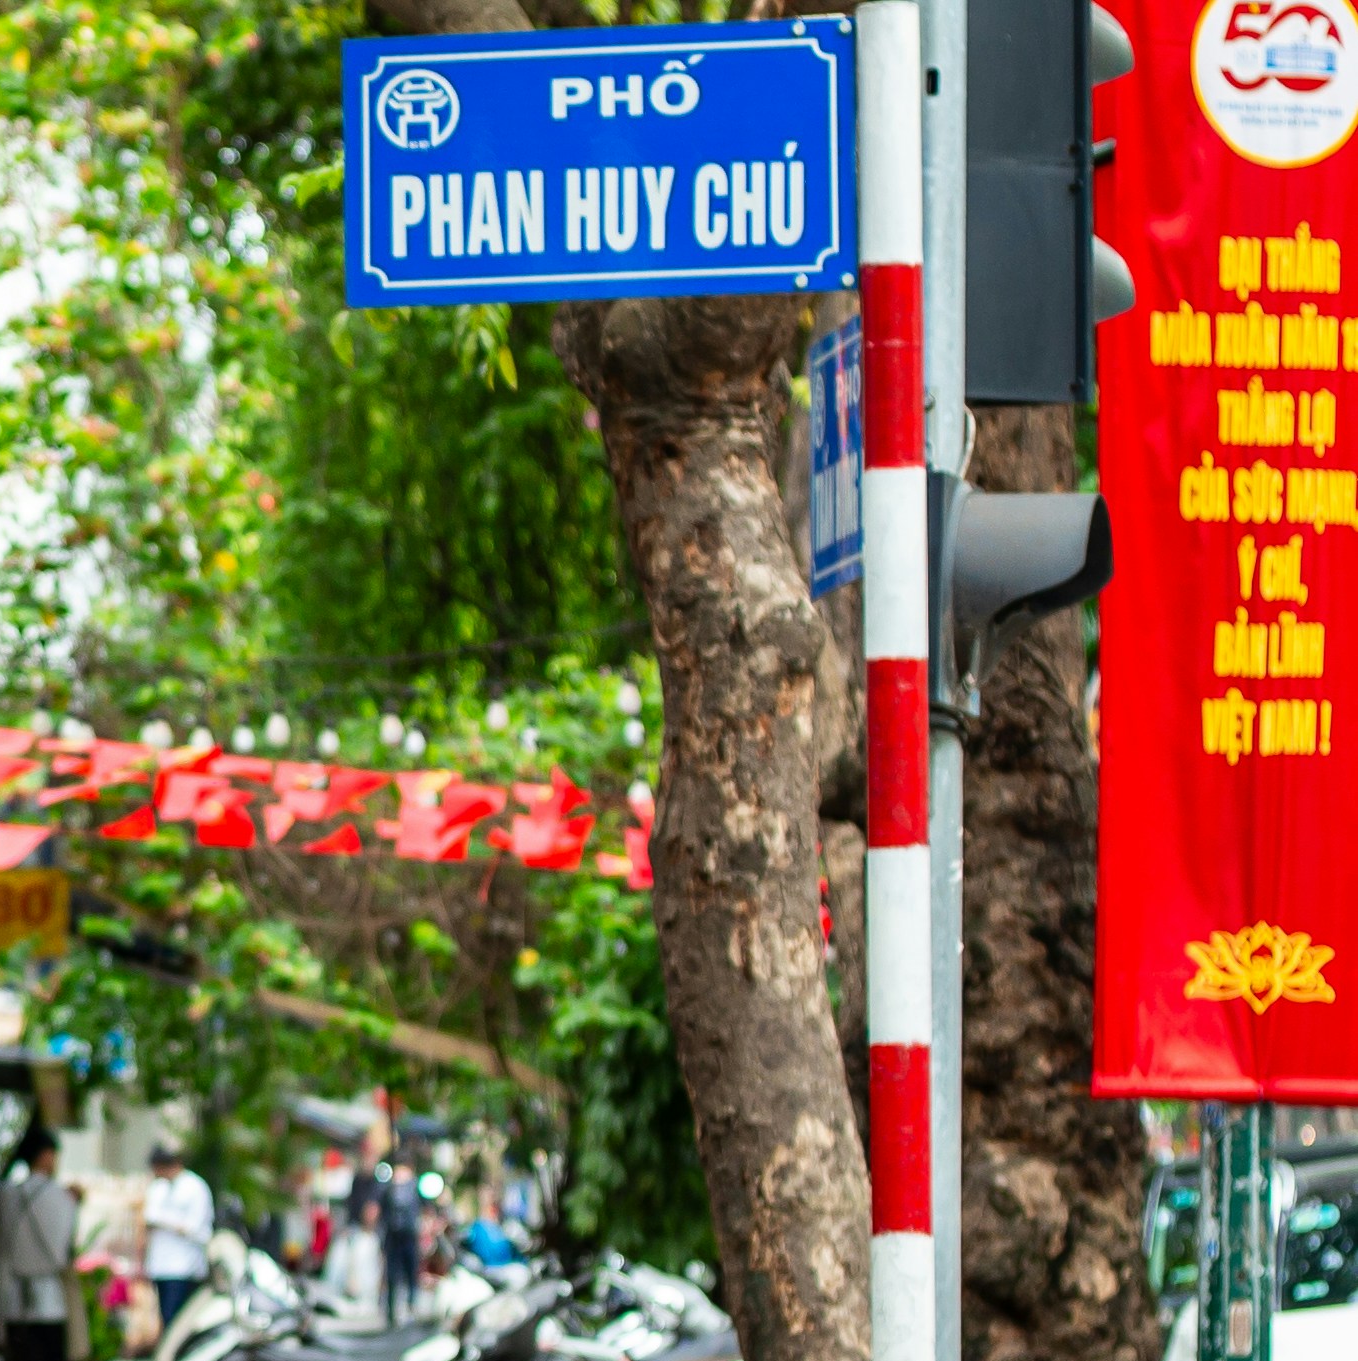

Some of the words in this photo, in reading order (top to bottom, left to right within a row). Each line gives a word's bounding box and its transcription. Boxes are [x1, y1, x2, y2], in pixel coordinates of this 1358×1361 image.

[551, 54, 704, 119] PHỐ
[391, 170, 544, 259] PHAN
[566, 165, 675, 252] HUY
[693, 141, 805, 249] CHÚ
[1219, 235, 1262, 302] ĐẠI
[1264, 221, 1341, 294] THẮNG
[1150, 299, 1213, 367] MÙA
[1214, 300, 1280, 370] XUÂN
[1281, 302, 1339, 371] NĂM
[1217, 374, 1295, 447] THẮNG
[1297, 388, 1336, 458] LỢI
[1179, 450, 1230, 522] CỦA
[1232, 458, 1284, 525] SỨC
[1237, 534, 1257, 601] Ý
[1213, 605, 1268, 679] BẢN
[1268, 610, 1325, 679] LĨNH
[1201, 687, 1257, 766] VIỆT
[1259, 699, 1317, 757] NAM
